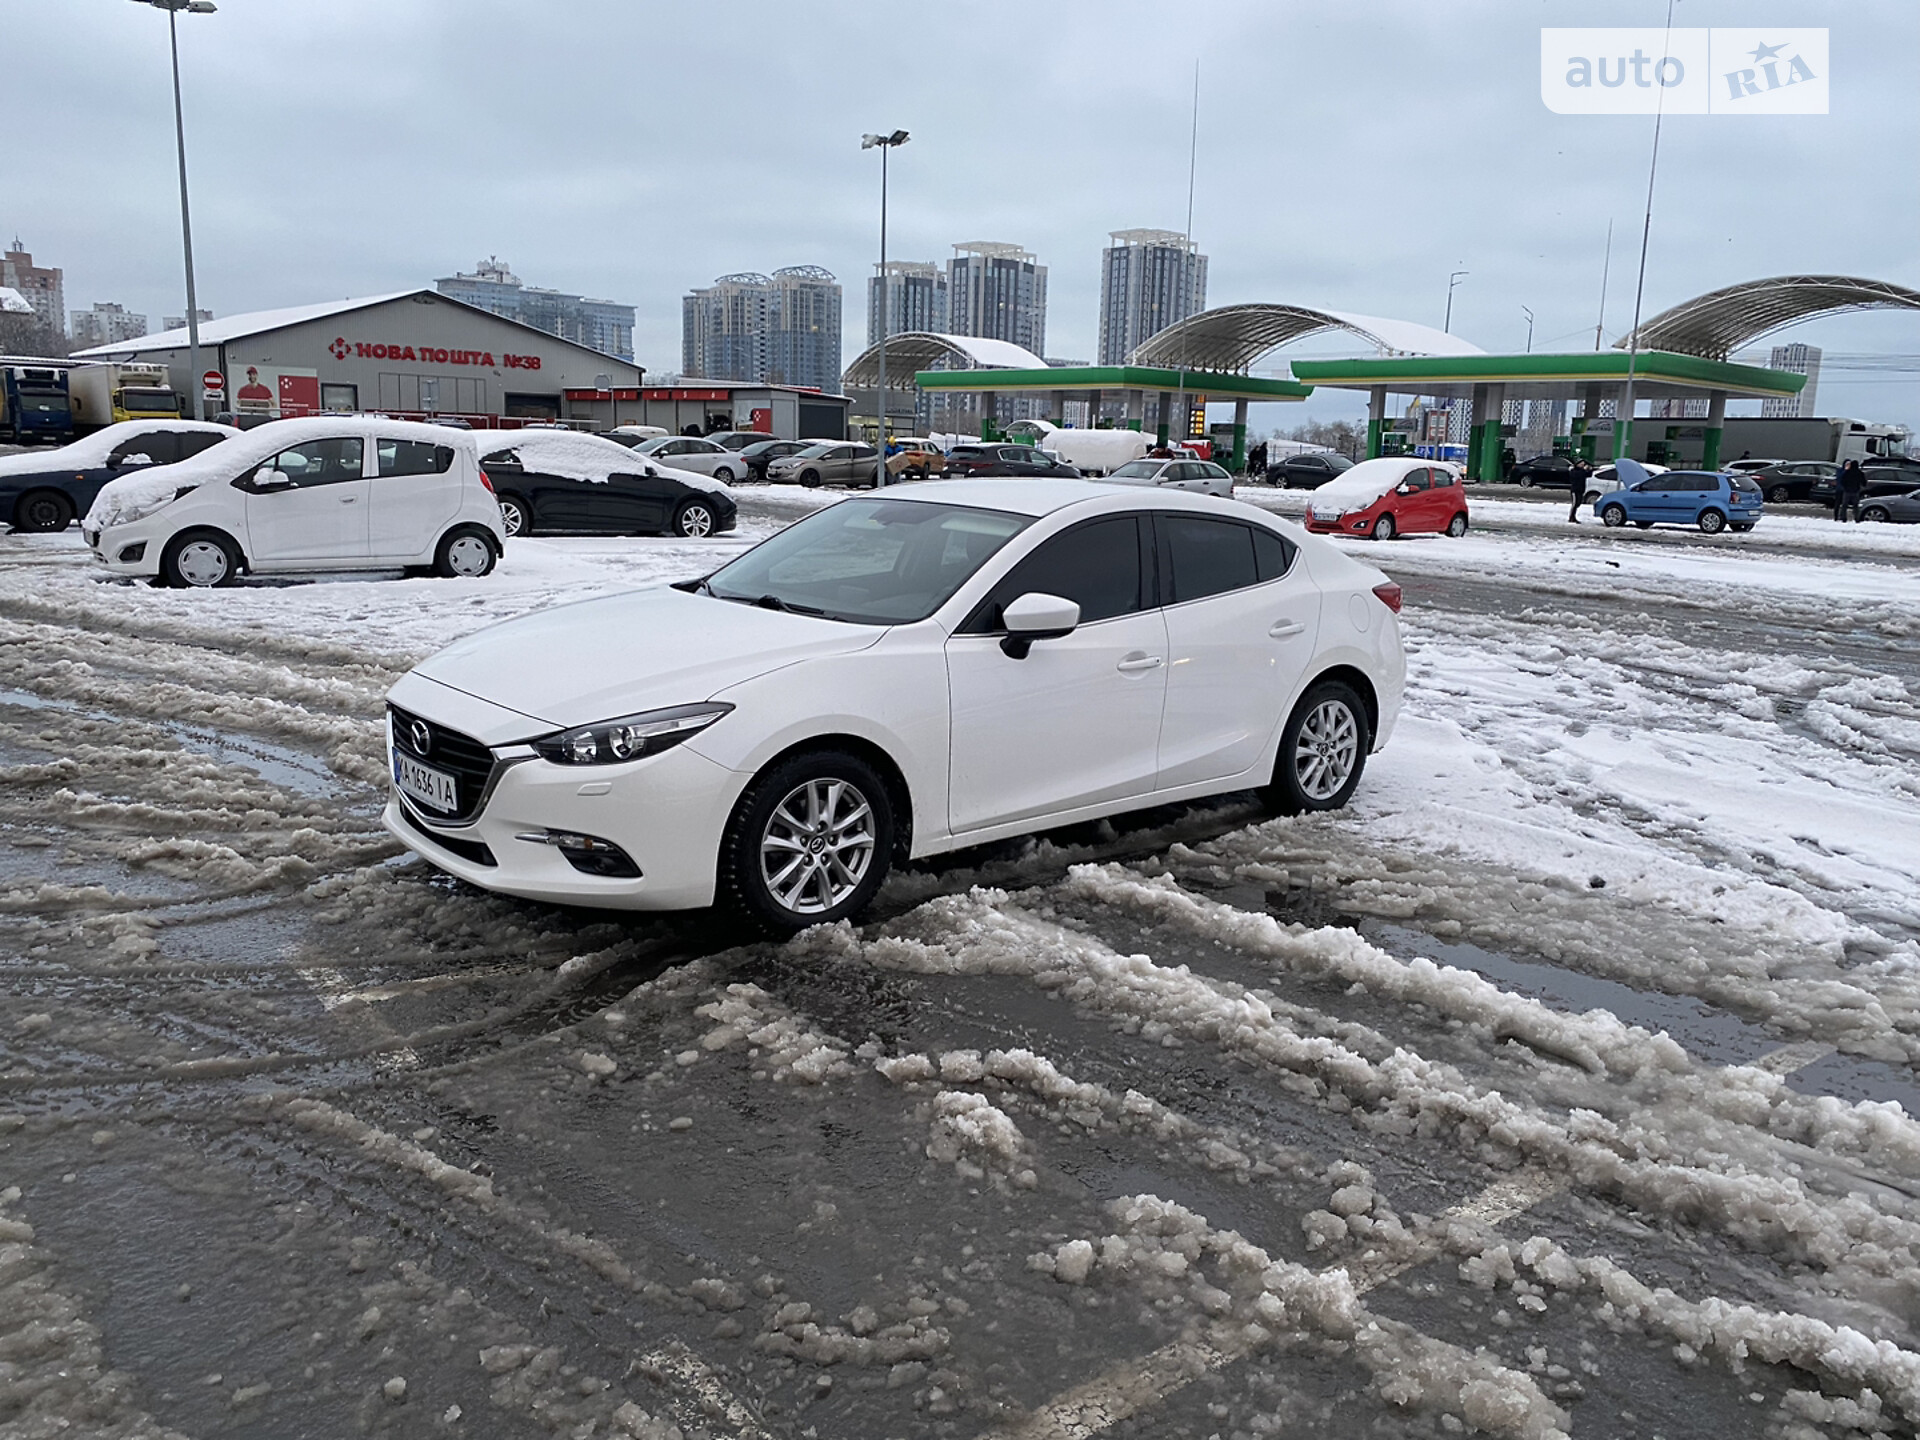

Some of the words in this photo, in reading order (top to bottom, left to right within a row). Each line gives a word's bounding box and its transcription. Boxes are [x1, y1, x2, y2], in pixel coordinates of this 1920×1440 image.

[356, 342, 416, 361] НОВА
[419, 347, 495, 366] ПОШТА
[504, 354, 541, 370] №38
[412, 765, 434, 796] 1636
[437, 777, 454, 805] IA
